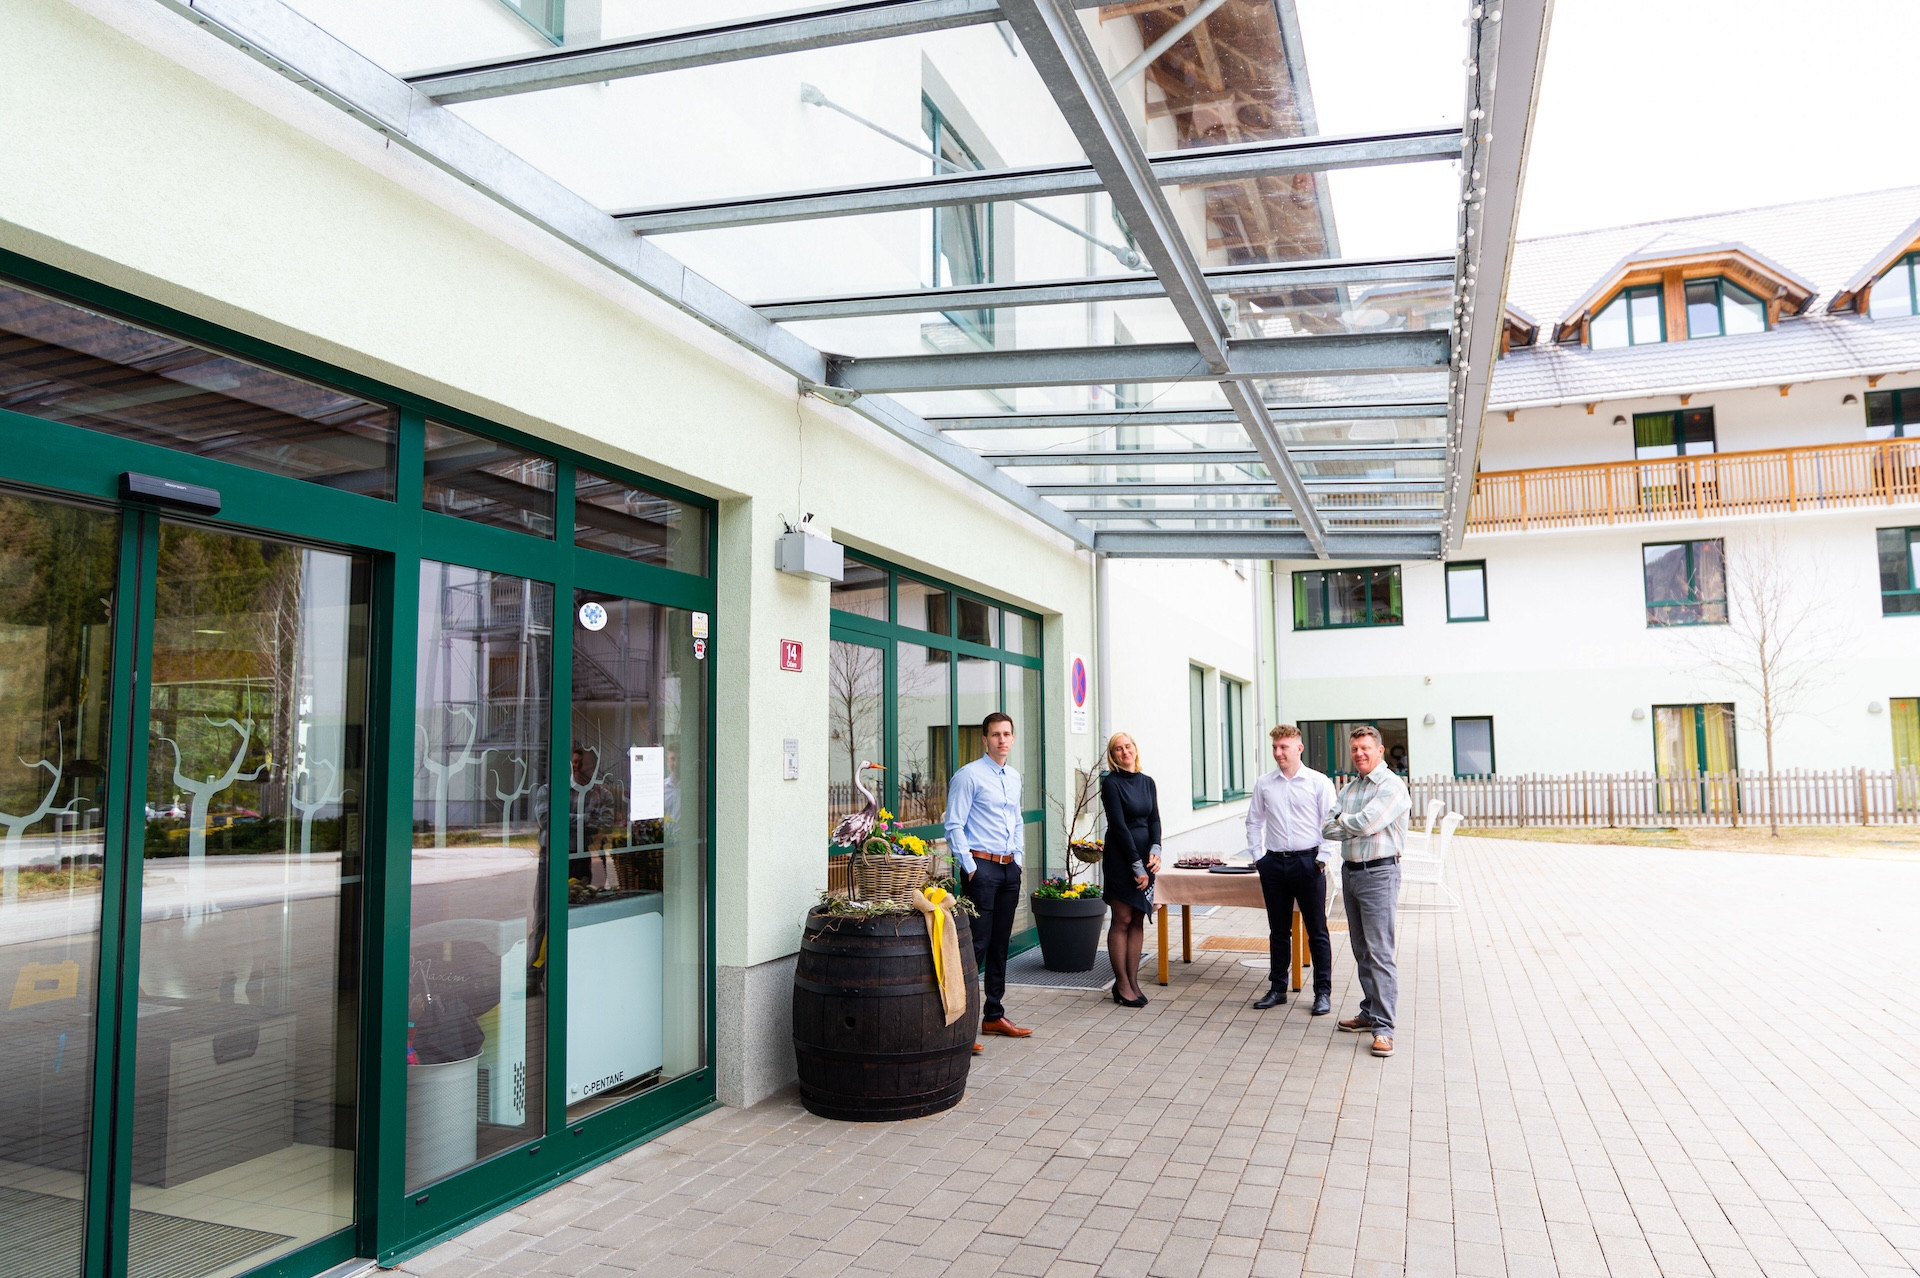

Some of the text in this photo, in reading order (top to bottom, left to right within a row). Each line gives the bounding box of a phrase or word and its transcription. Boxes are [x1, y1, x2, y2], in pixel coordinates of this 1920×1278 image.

[786, 643, 797, 660] 14
[410, 955, 471, 983] Maxim
[583, 1070, 624, 1096] C-PENTANE
